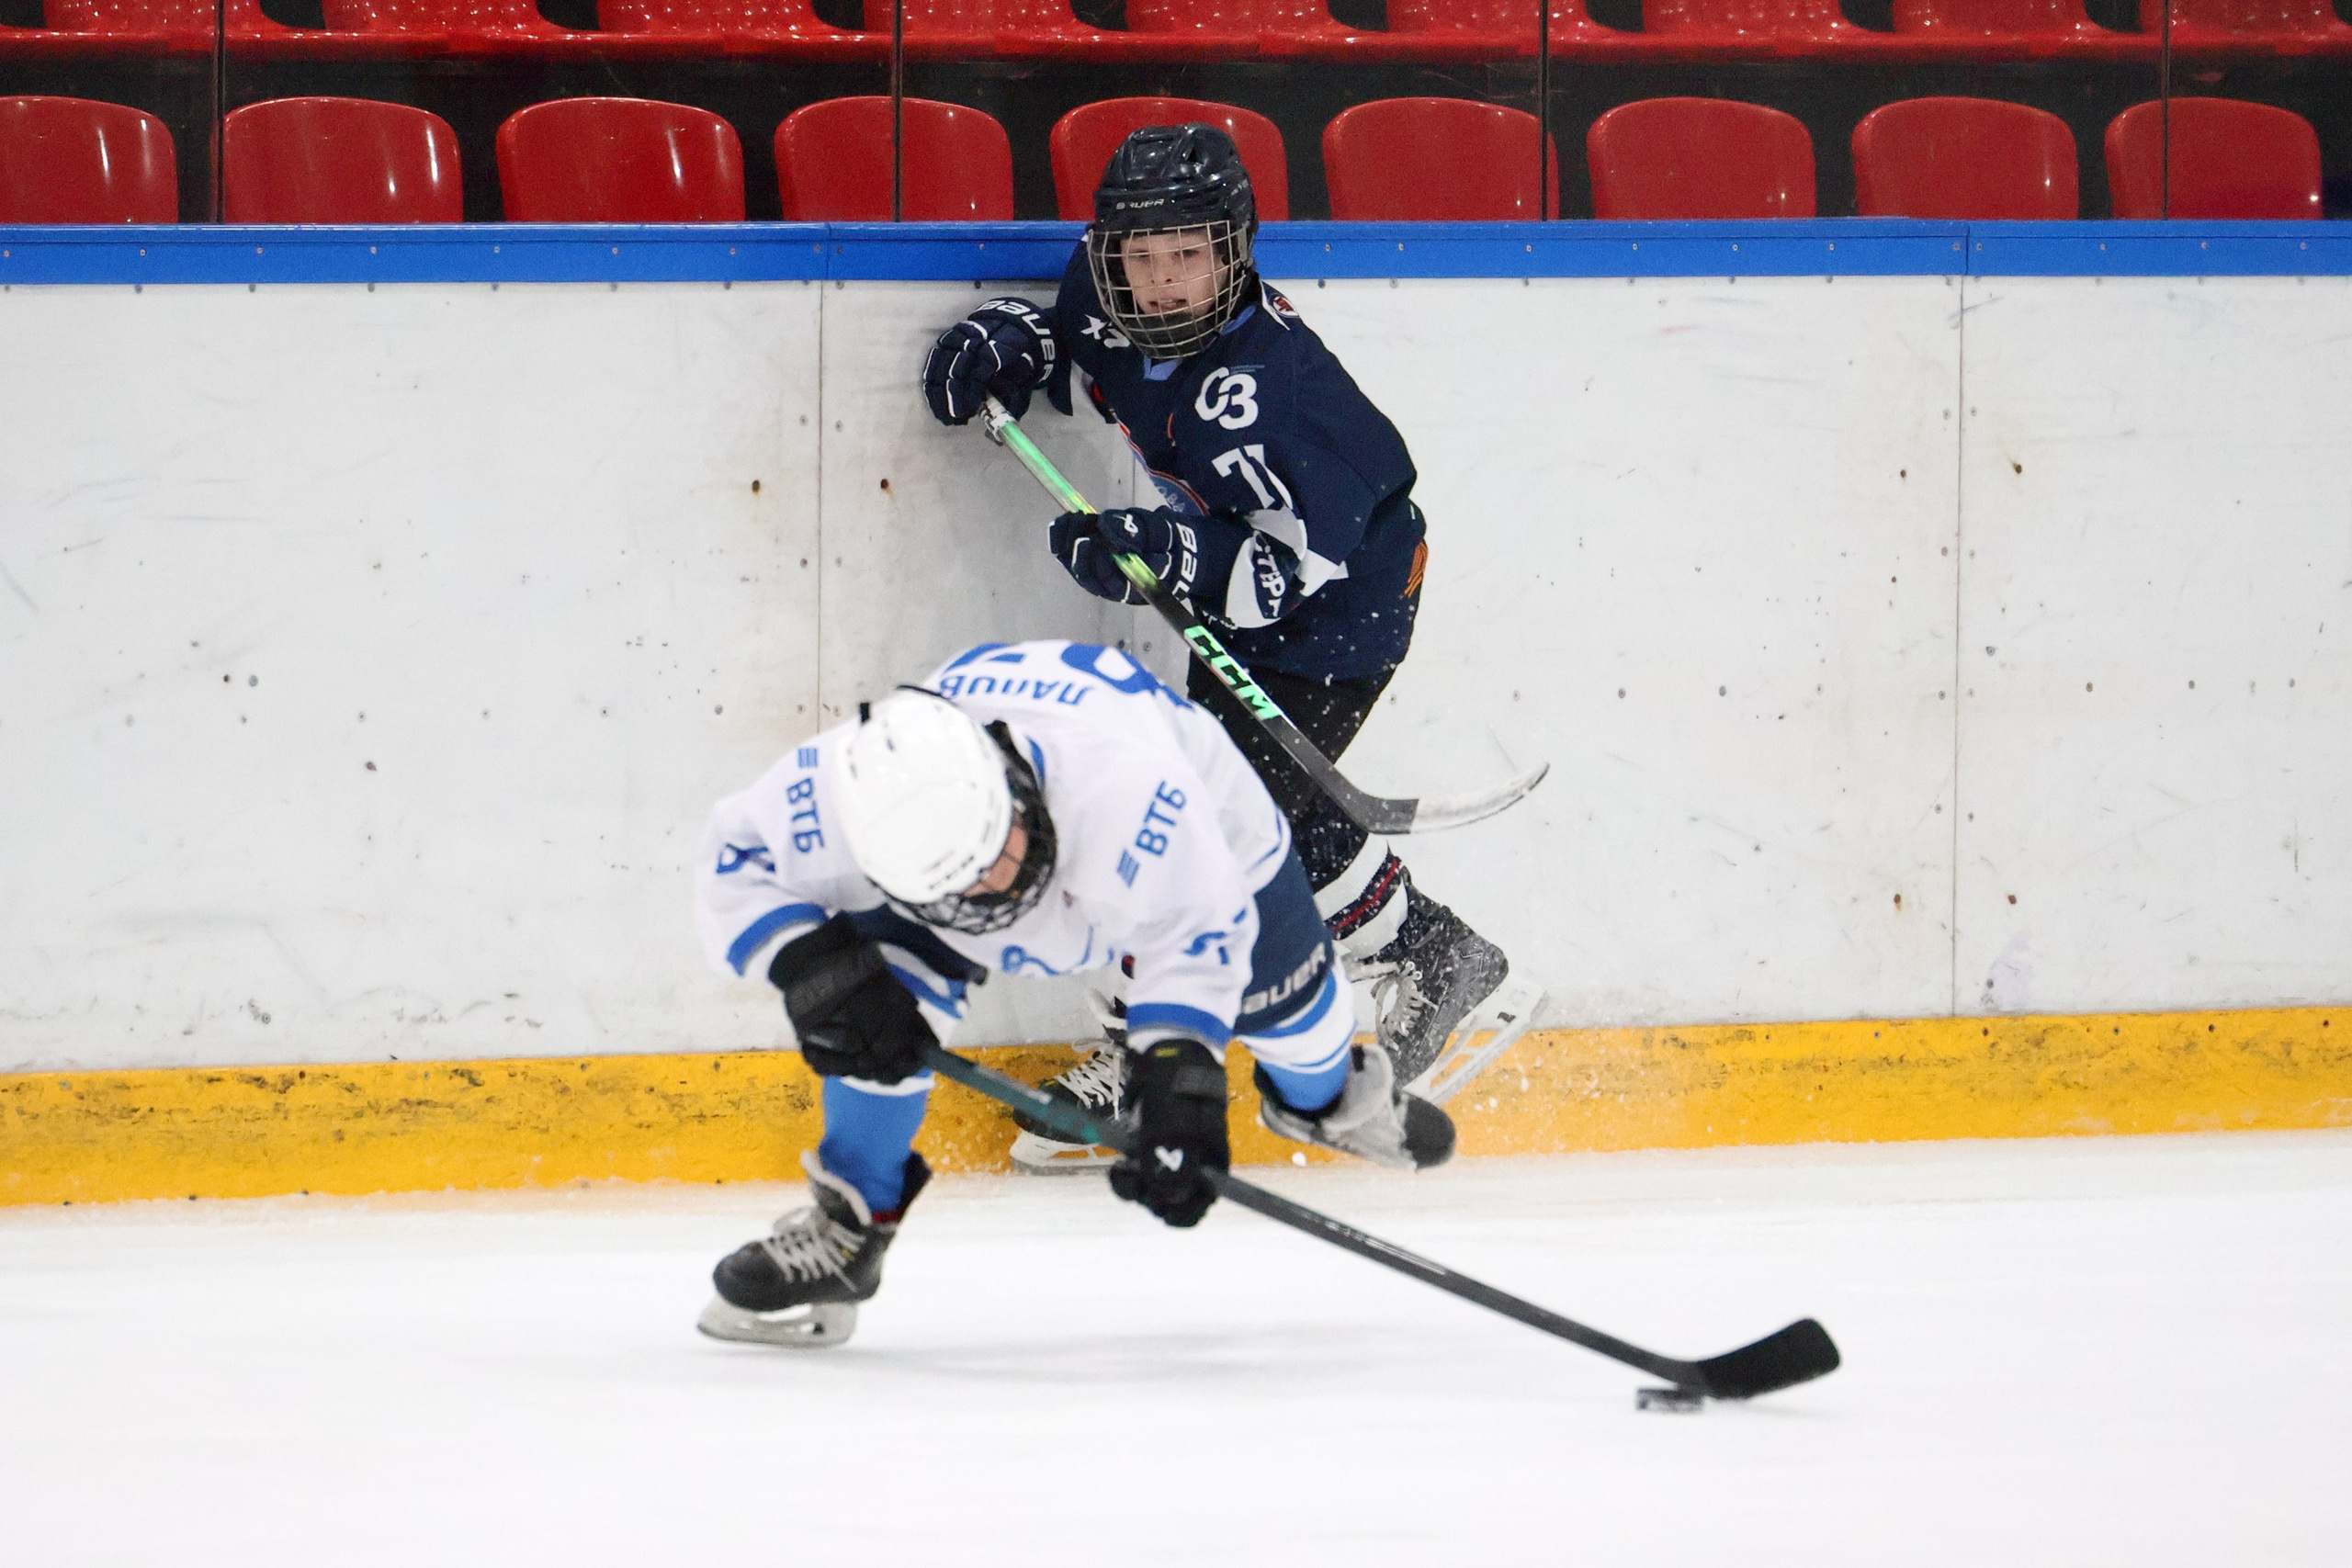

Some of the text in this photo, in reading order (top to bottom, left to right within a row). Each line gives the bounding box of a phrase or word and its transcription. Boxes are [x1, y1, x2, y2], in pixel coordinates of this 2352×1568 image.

[976, 300, 1056, 382] BAUER
[1183, 625, 1283, 721] CCM
[786, 777, 825, 852] ВТБ
[1135, 780, 1187, 857] ВТБ
[1241, 942, 1327, 1014] AUER
